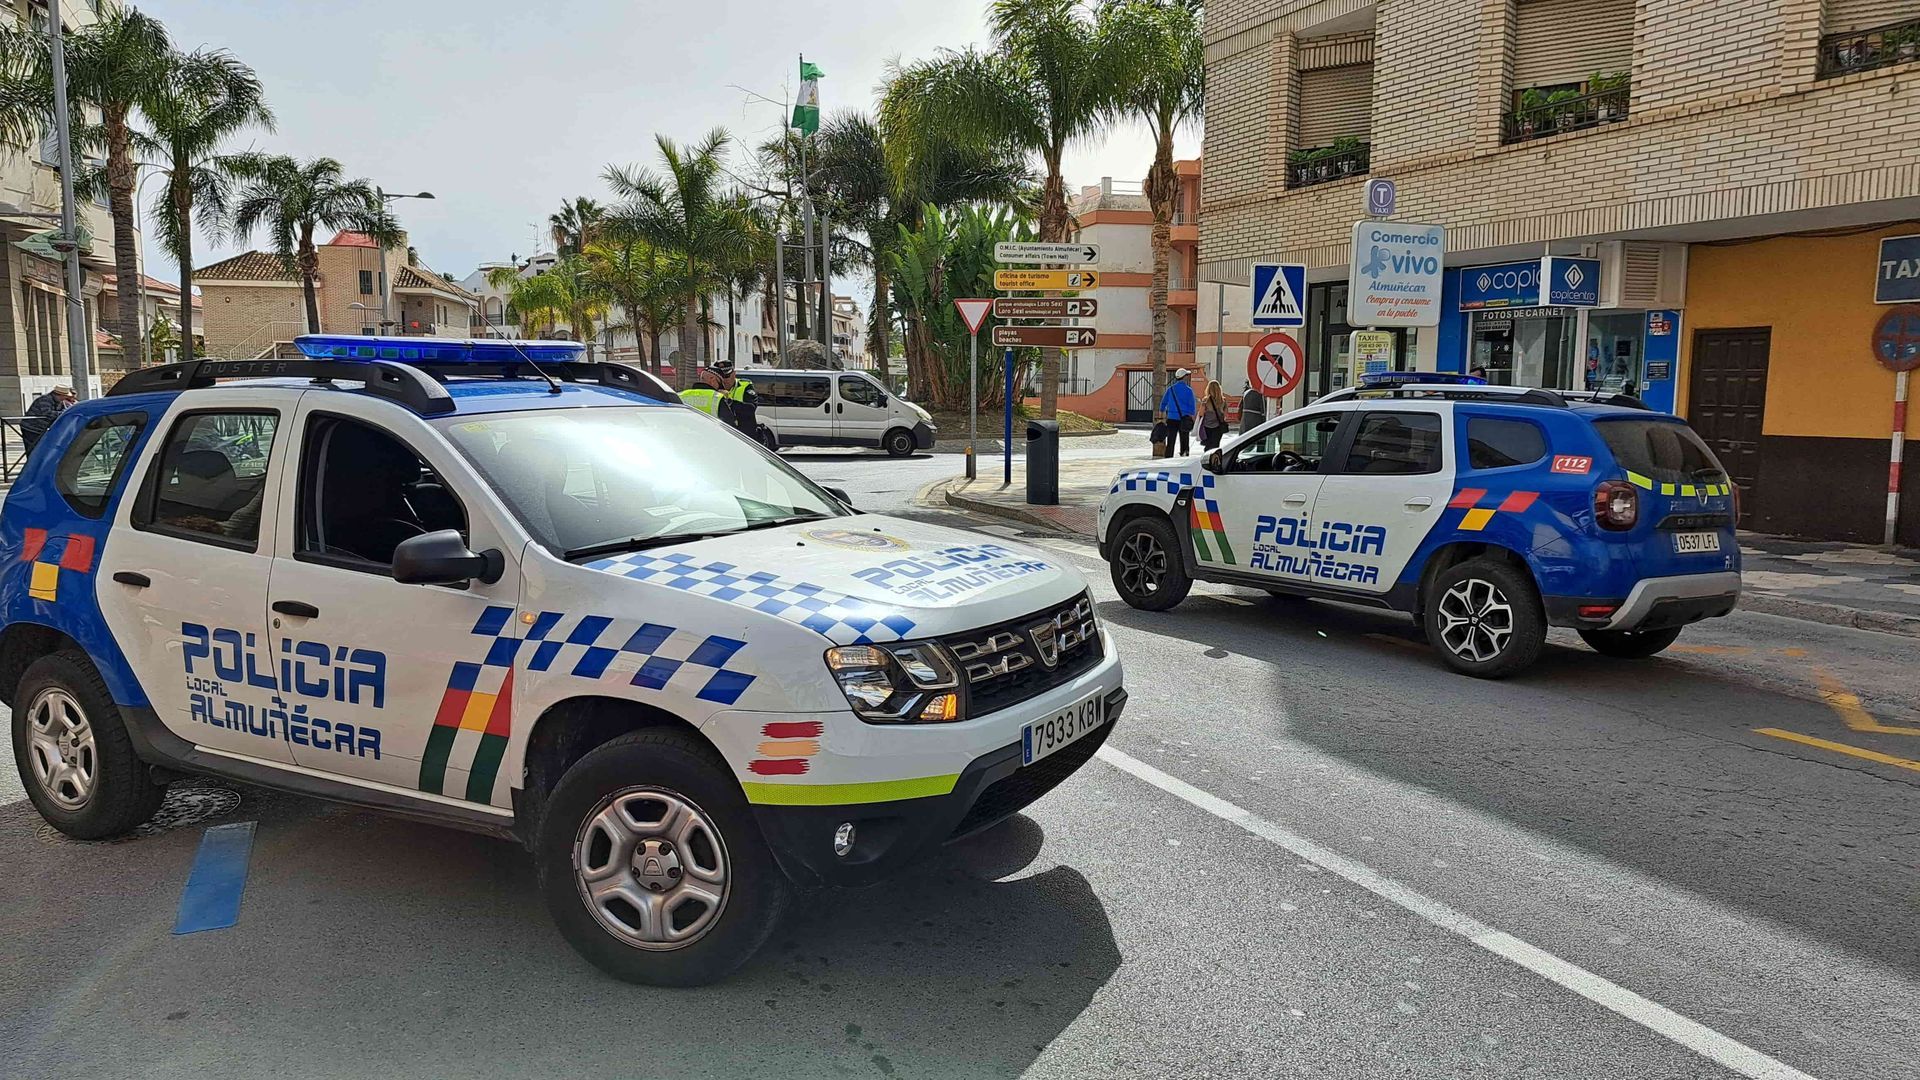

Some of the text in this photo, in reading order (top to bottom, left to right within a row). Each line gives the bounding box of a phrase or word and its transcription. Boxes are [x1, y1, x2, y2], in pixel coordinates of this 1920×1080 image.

[1370, 231, 1439, 246] Comercio
[1392, 251, 1438, 275] vivo
[1368, 280, 1426, 293] Almuñécar
[1365, 295, 1432, 307] Compra y consume
[1551, 290, 1595, 301] copicentro
[1377, 309, 1418, 319] en tu pueblo
[1482, 308, 1565, 320] FOTOS DE CARNET
[202, 362, 287, 374] DUSTER
[1564, 457, 1588, 468] 112
[1252, 543, 1281, 554] LOCAL
[1678, 534, 1718, 550] 0537 LFL
[1250, 551, 1380, 585] ALMUÑÉCAR
[891, 578, 935, 595] LOCAL
[186, 675, 228, 697] LOCAL
[190, 693, 382, 761] ALMUÑÉCAR
[1035, 710, 1074, 755] 7933
